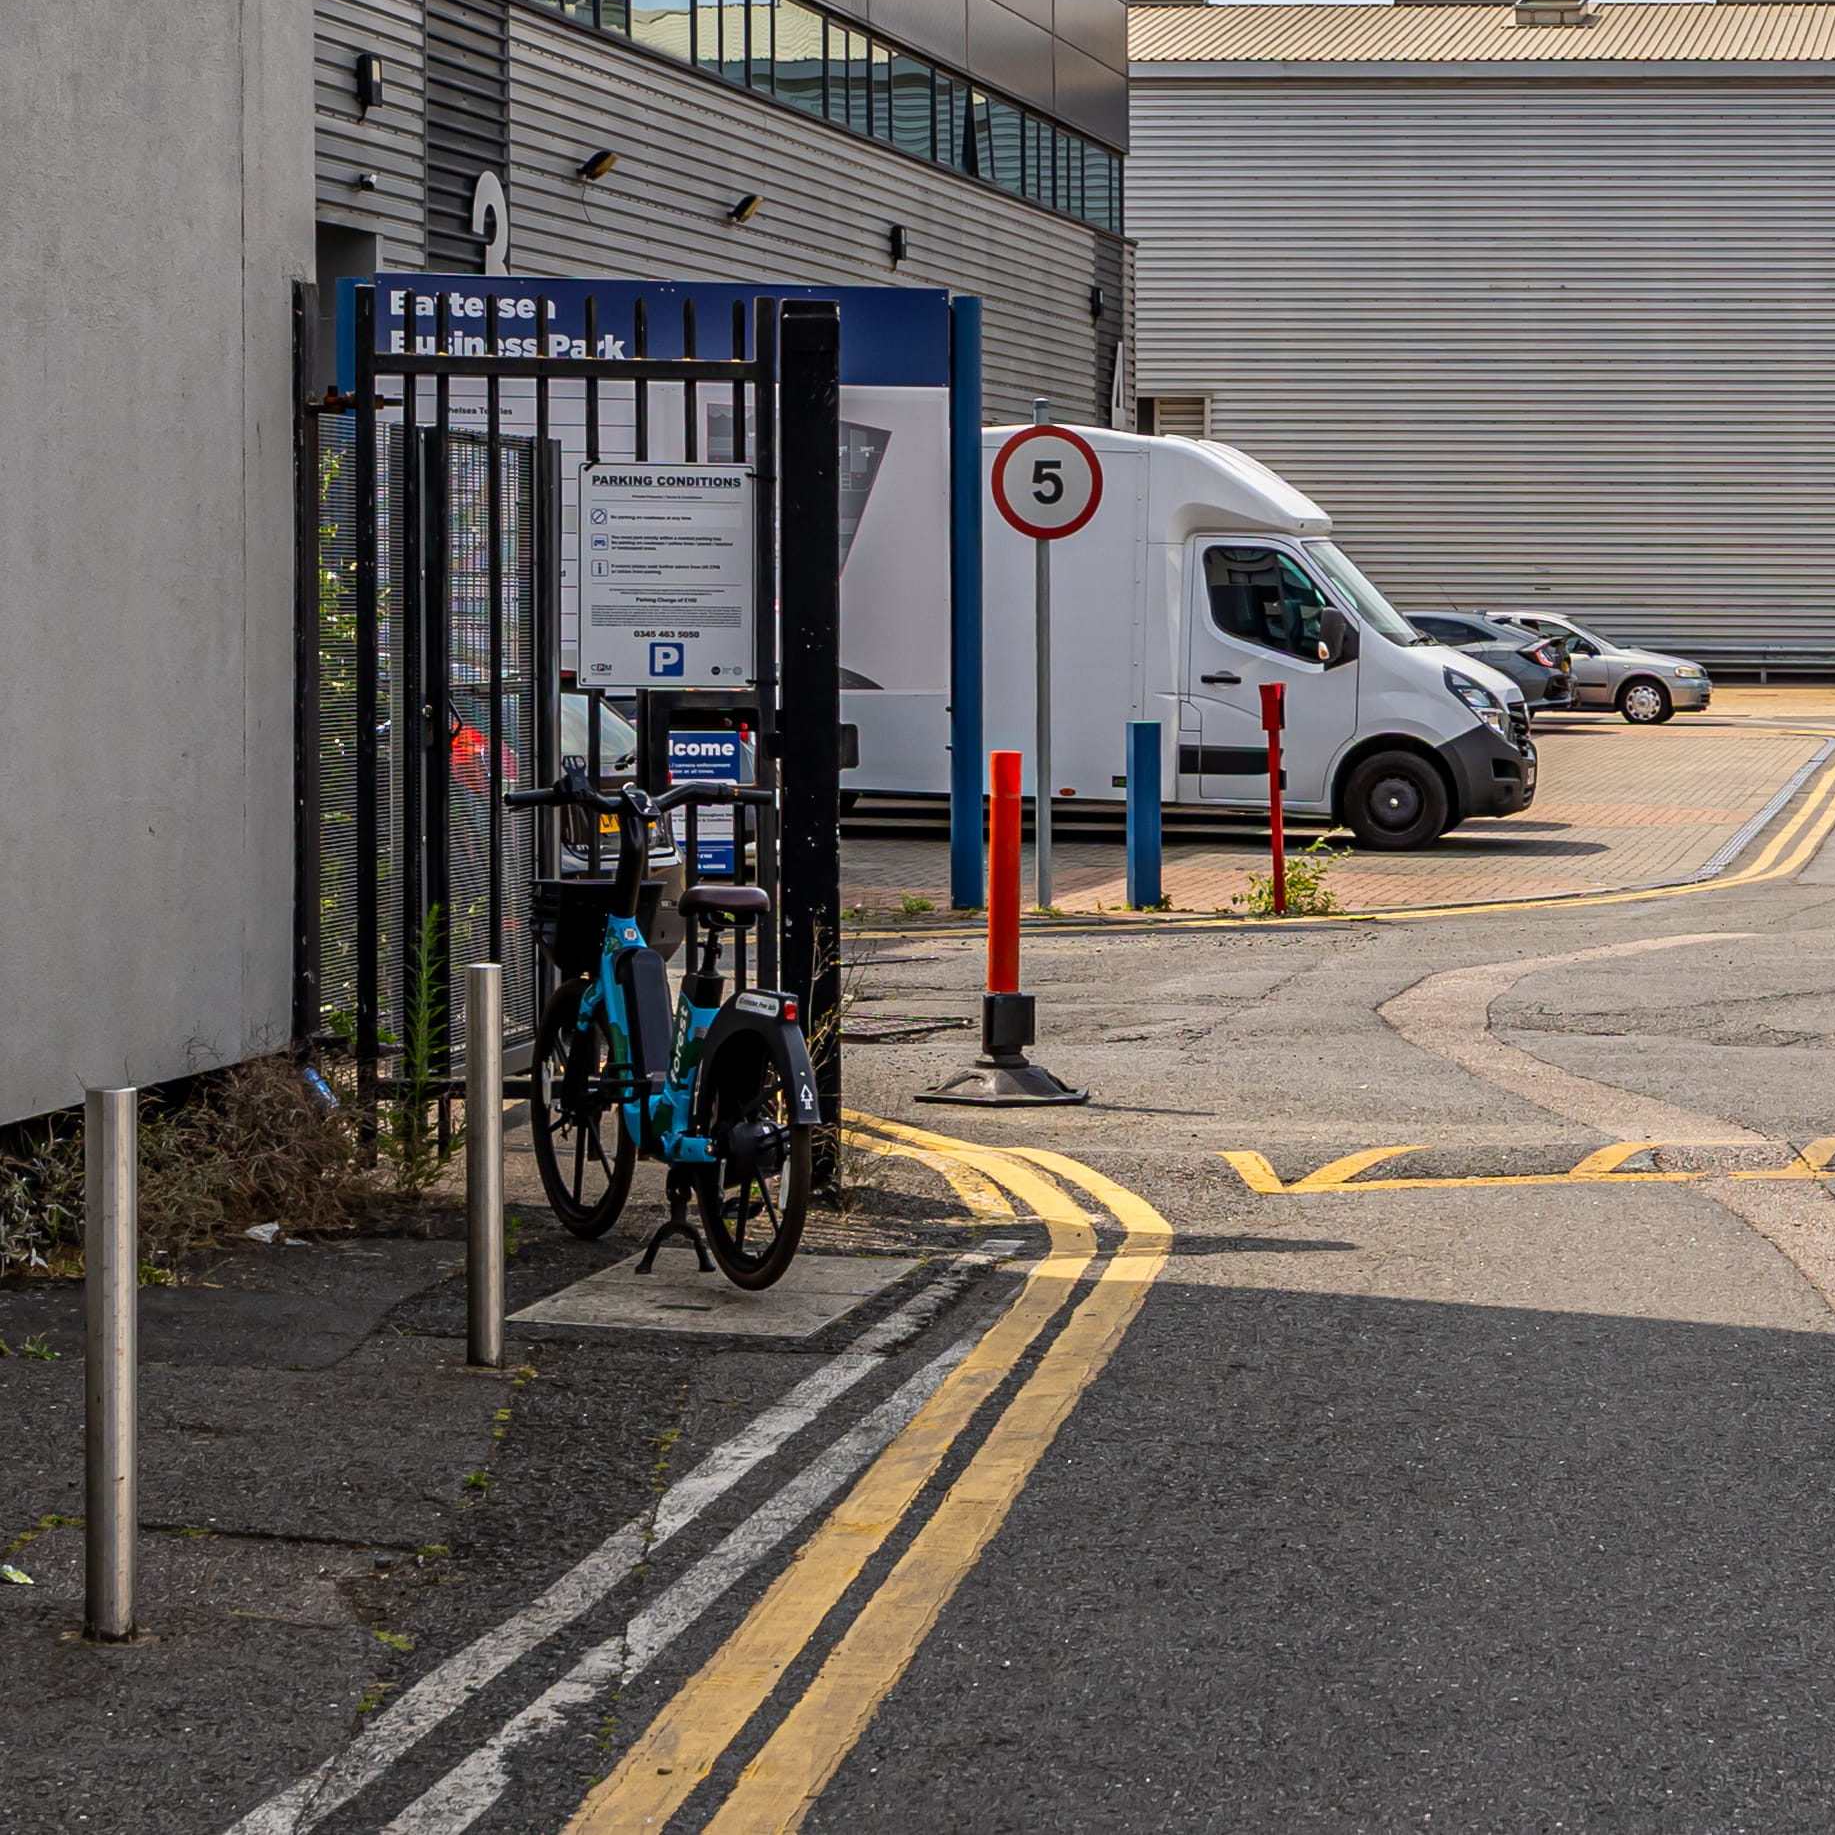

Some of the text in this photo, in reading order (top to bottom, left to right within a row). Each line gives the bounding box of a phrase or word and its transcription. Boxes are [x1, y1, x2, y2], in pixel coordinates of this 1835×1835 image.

[448, 406, 477, 415] helsea
[592, 475, 741, 487] PARKING CONDITIONS
[1032, 460, 1063, 504] 5
[634, 630, 656, 638] 0345
[654, 646, 679, 673] P
[668, 739, 735, 757] lcome
